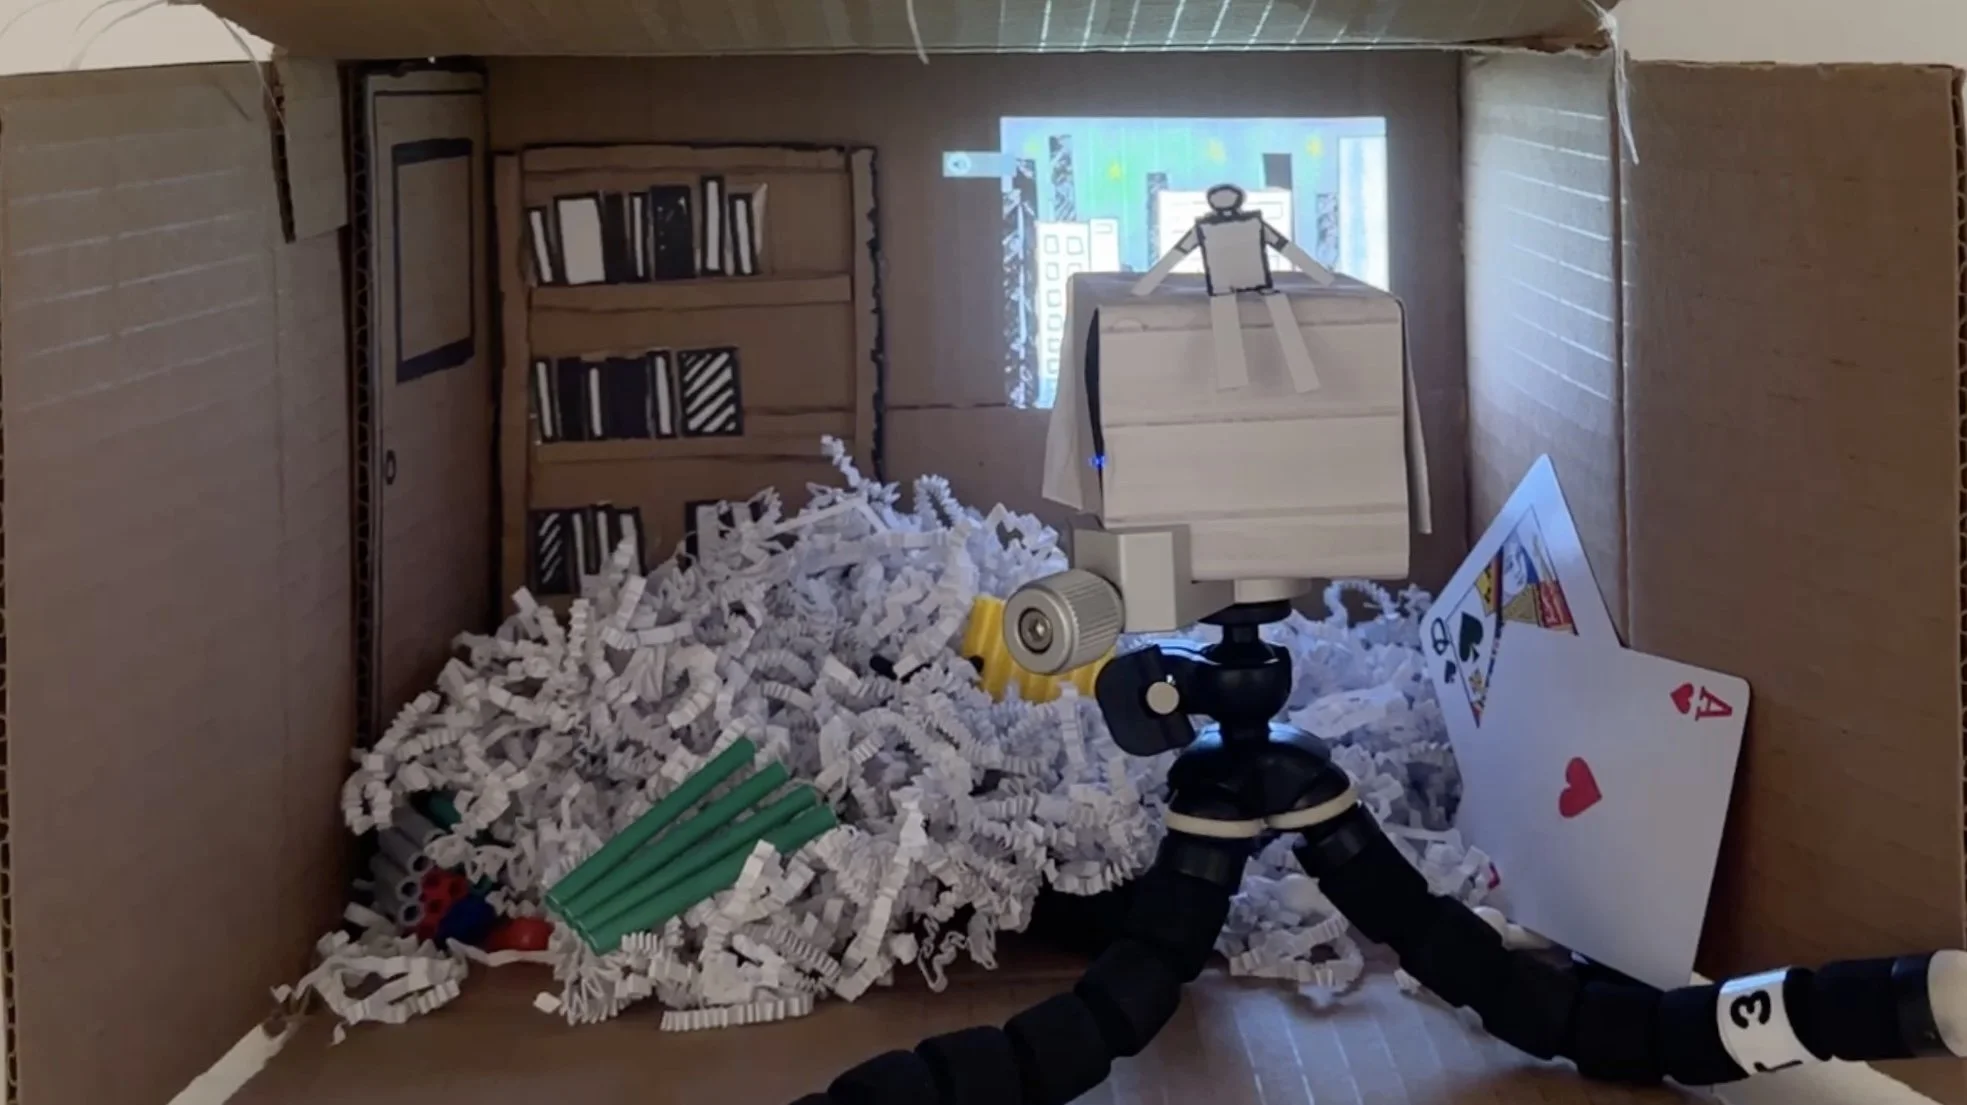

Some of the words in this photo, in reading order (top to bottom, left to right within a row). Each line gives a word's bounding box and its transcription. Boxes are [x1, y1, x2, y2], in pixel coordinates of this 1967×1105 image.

[1430, 616, 1449, 656] Q
[1694, 685, 1733, 722] A
[1730, 990, 1771, 1029] 3
